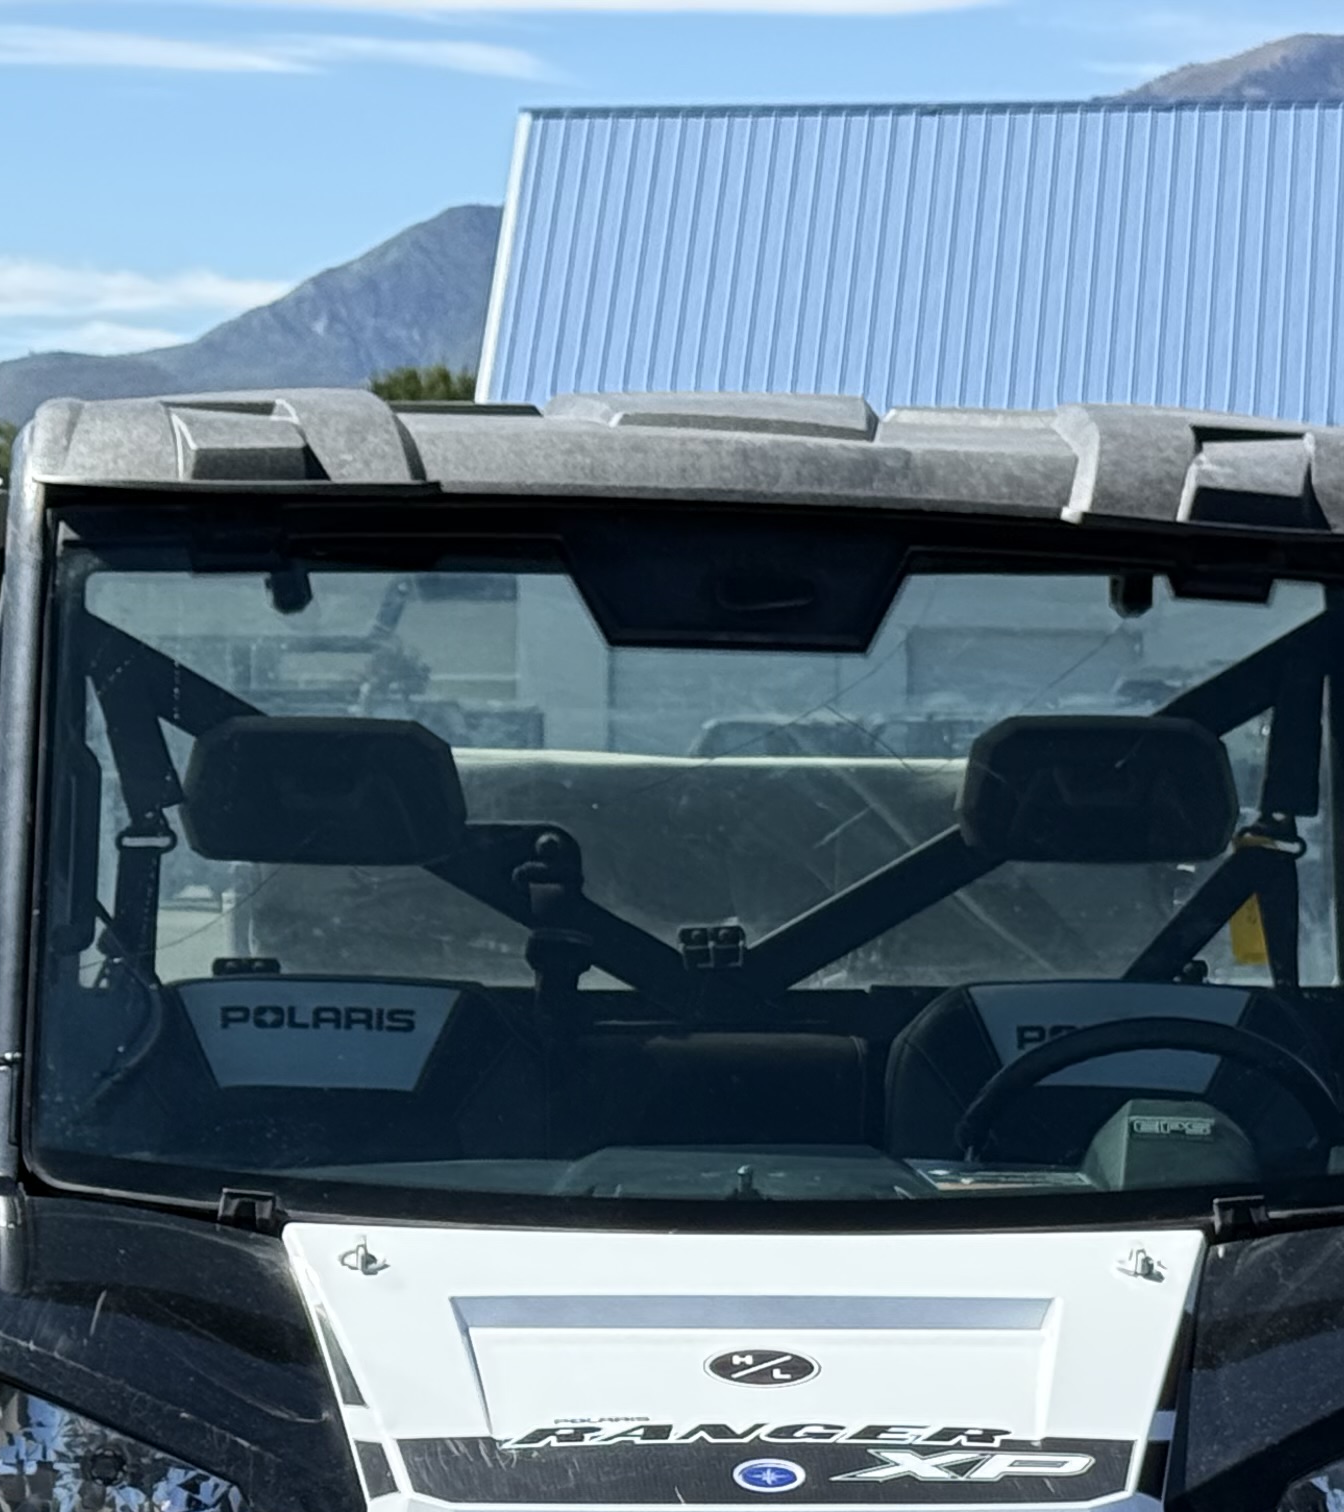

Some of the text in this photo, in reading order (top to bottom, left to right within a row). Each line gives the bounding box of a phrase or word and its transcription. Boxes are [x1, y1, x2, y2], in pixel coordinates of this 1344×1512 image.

[220, 1005, 416, 1033] POLARIS
[501, 1422, 1012, 1449] RANGER
[829, 1449, 1097, 1482] XP
